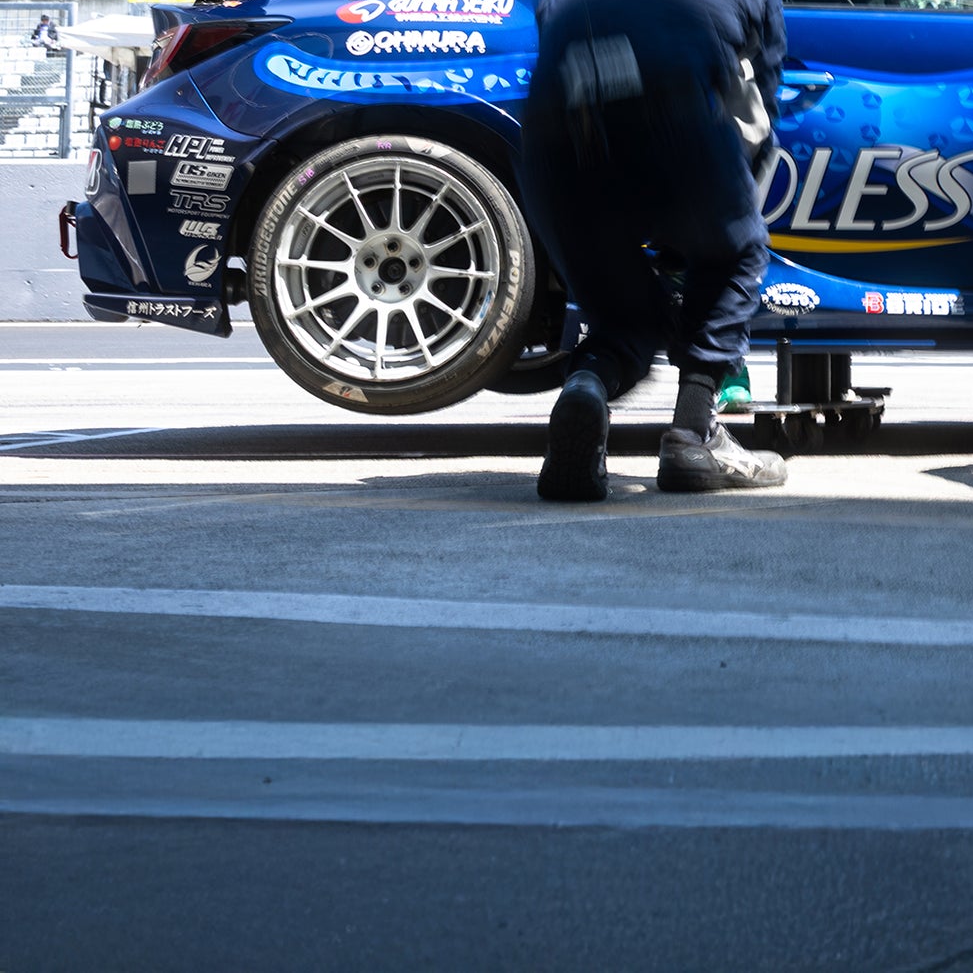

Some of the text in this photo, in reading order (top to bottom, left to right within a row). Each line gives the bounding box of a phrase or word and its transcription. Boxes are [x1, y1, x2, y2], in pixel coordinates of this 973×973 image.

[170, 189, 231, 213] TRS
[253, 184, 299, 297] BRIDGESTONE
[127, 300, 217, 318] 信州トラストフーズ
[476, 249, 520, 358] POTENZA
